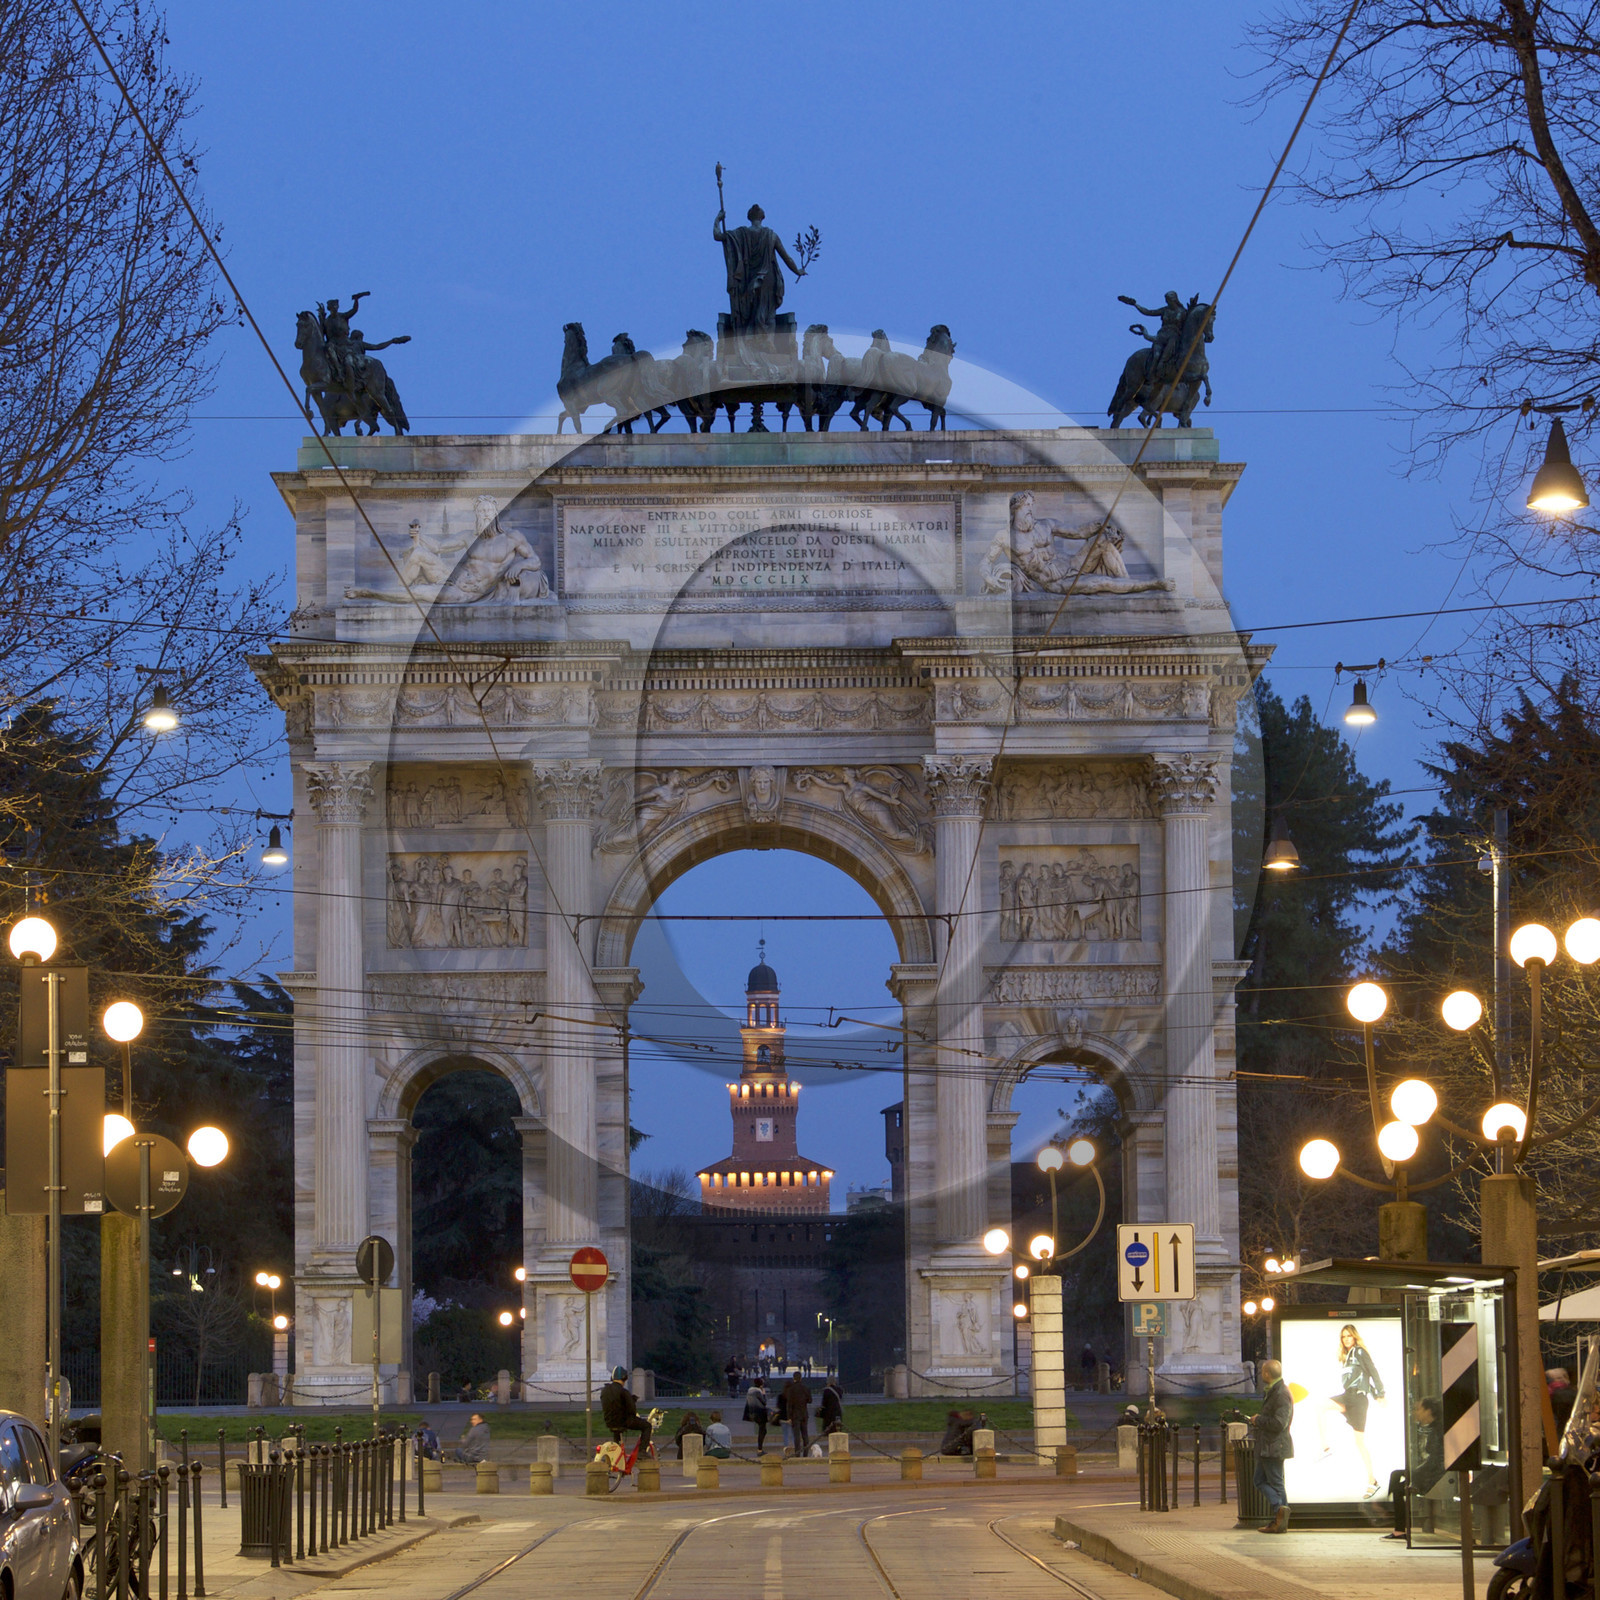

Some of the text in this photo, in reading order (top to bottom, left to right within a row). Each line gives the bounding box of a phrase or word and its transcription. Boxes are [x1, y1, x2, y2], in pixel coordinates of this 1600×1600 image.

[648, 511, 716, 521] ENTRANDO
[770, 509, 802, 519] ARMI
[812, 509, 873, 519] GLORIOSE
[570, 521, 949, 535] NAPOLEONE III E VITTORIO EMANUELE II LIBERATORI
[593, 537, 644, 548] MILANO
[655, 537, 723, 547] ESULTANTE
[806, 536, 822, 546] DA
[831, 535, 876, 545] QUESTI
[885, 534, 926, 545] MARMI
[685, 549, 835, 560] LE IMPRONTE SERVILI
[613, 563, 620, 573] E
[632, 563, 645, 573] VI
[655, 563, 705, 573] SCRISSE
[732, 562, 831, 572] INDIPENDENZA
[862, 561, 906, 571] ITALIA
[1140, 1304, 1159, 1328] P
